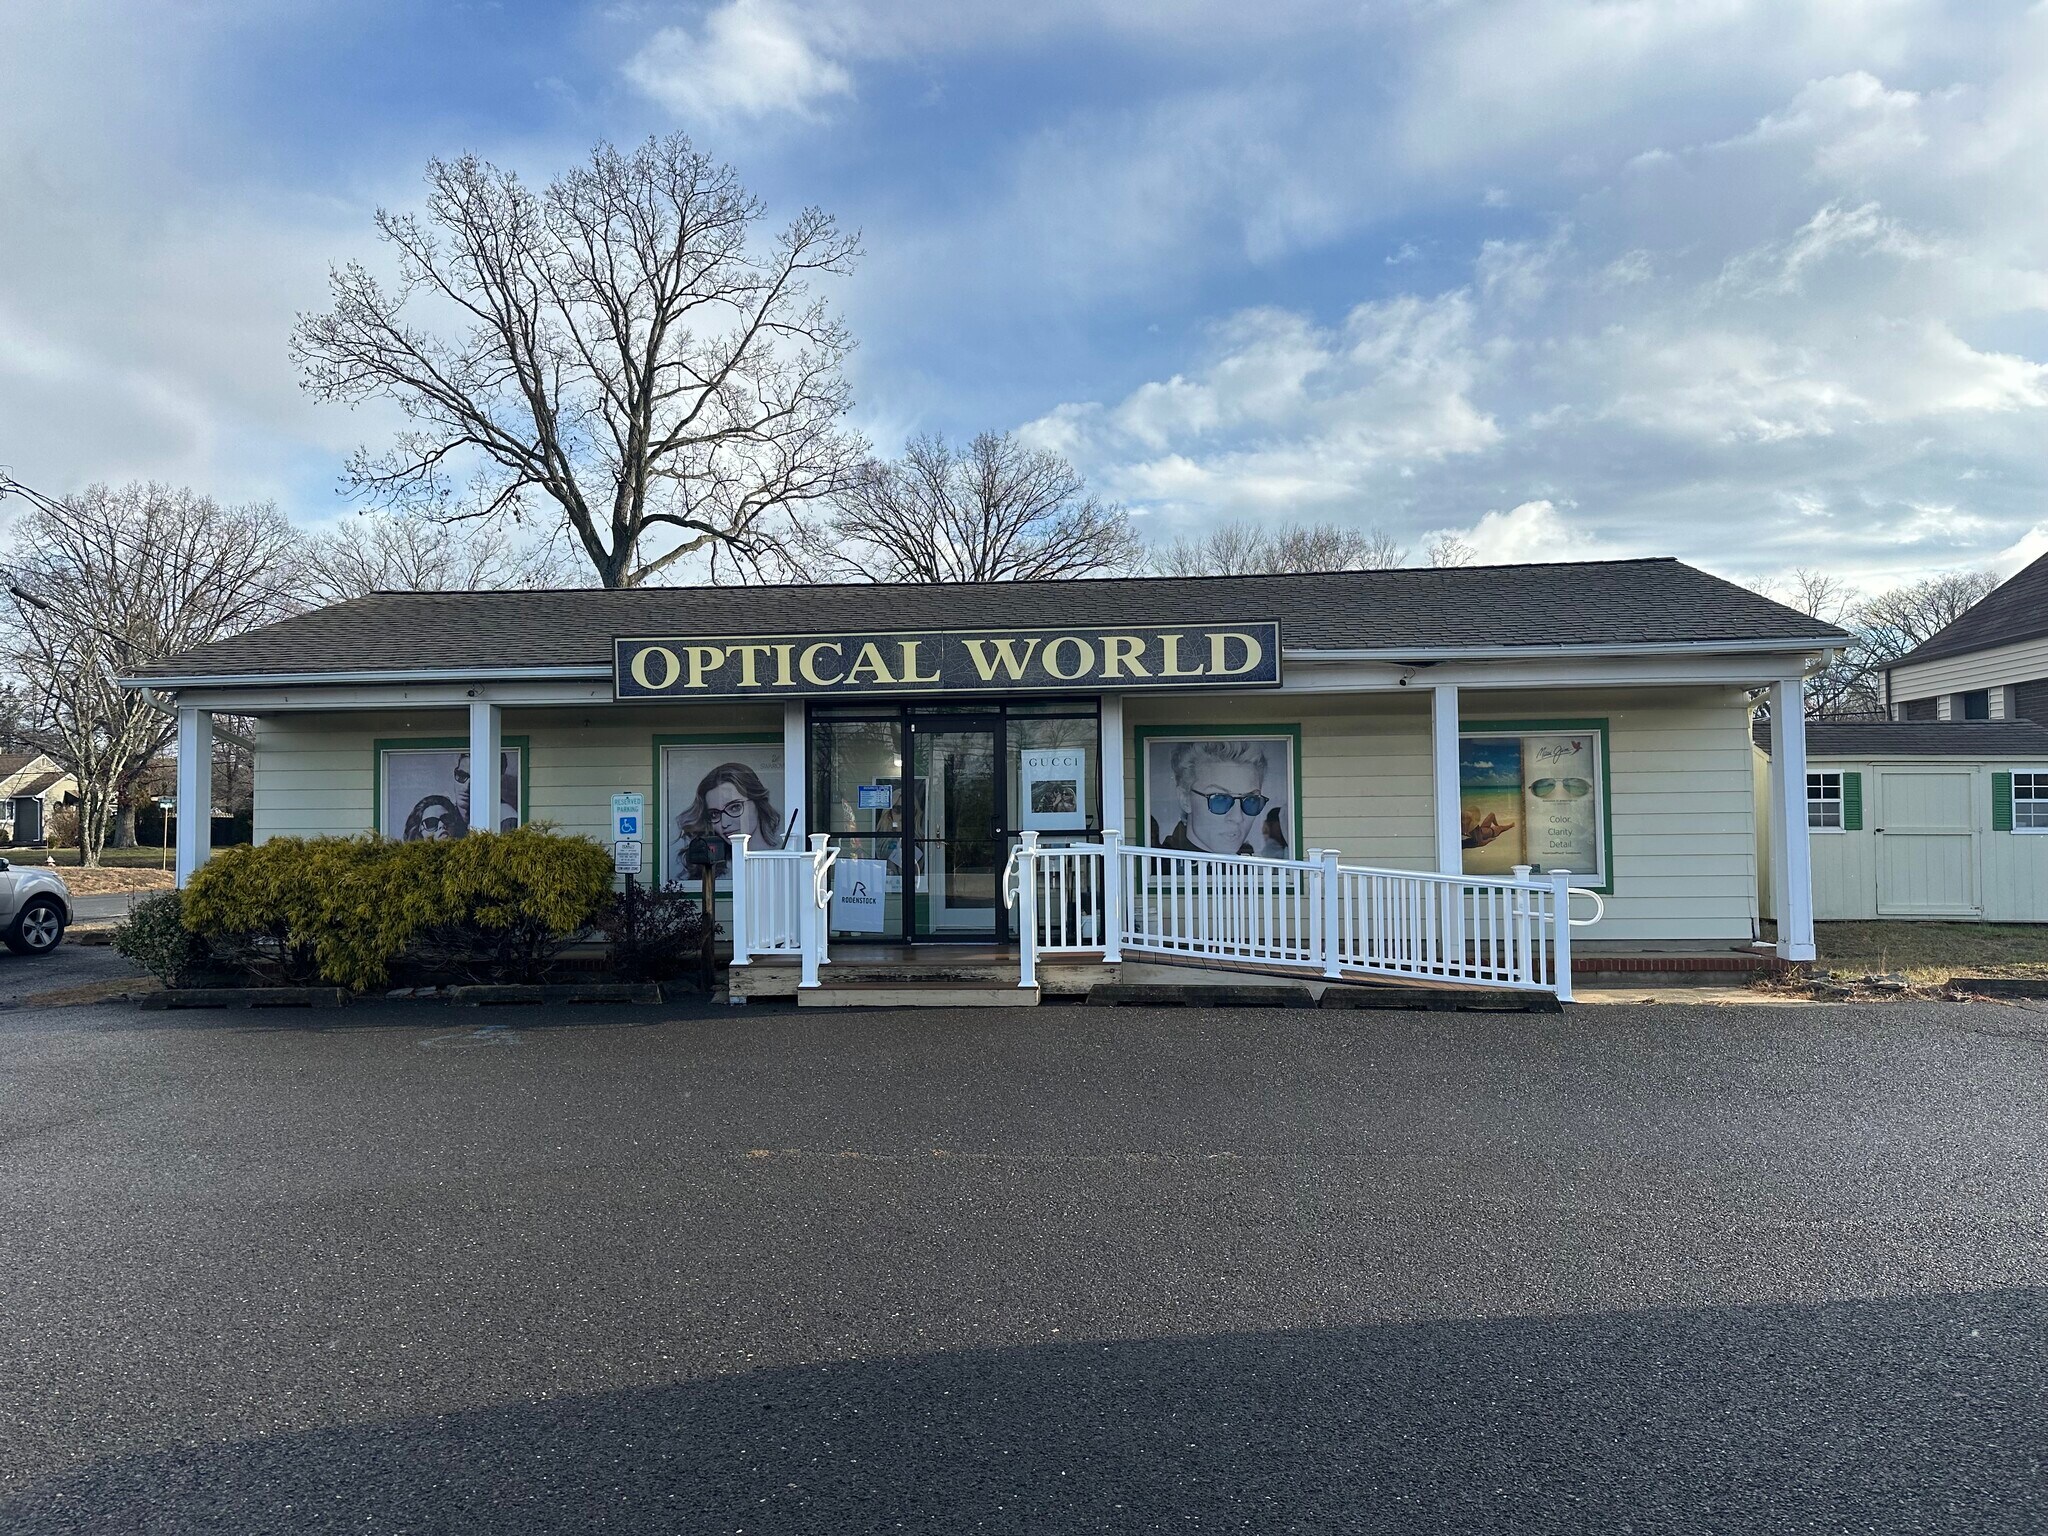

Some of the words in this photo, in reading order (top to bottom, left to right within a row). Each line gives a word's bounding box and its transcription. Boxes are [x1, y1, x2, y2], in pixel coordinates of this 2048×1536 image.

[629, 641, 941, 690] OPTICAL
[960, 632, 1263, 681] WORLD
[1029, 758, 1078, 767] GUCCI
